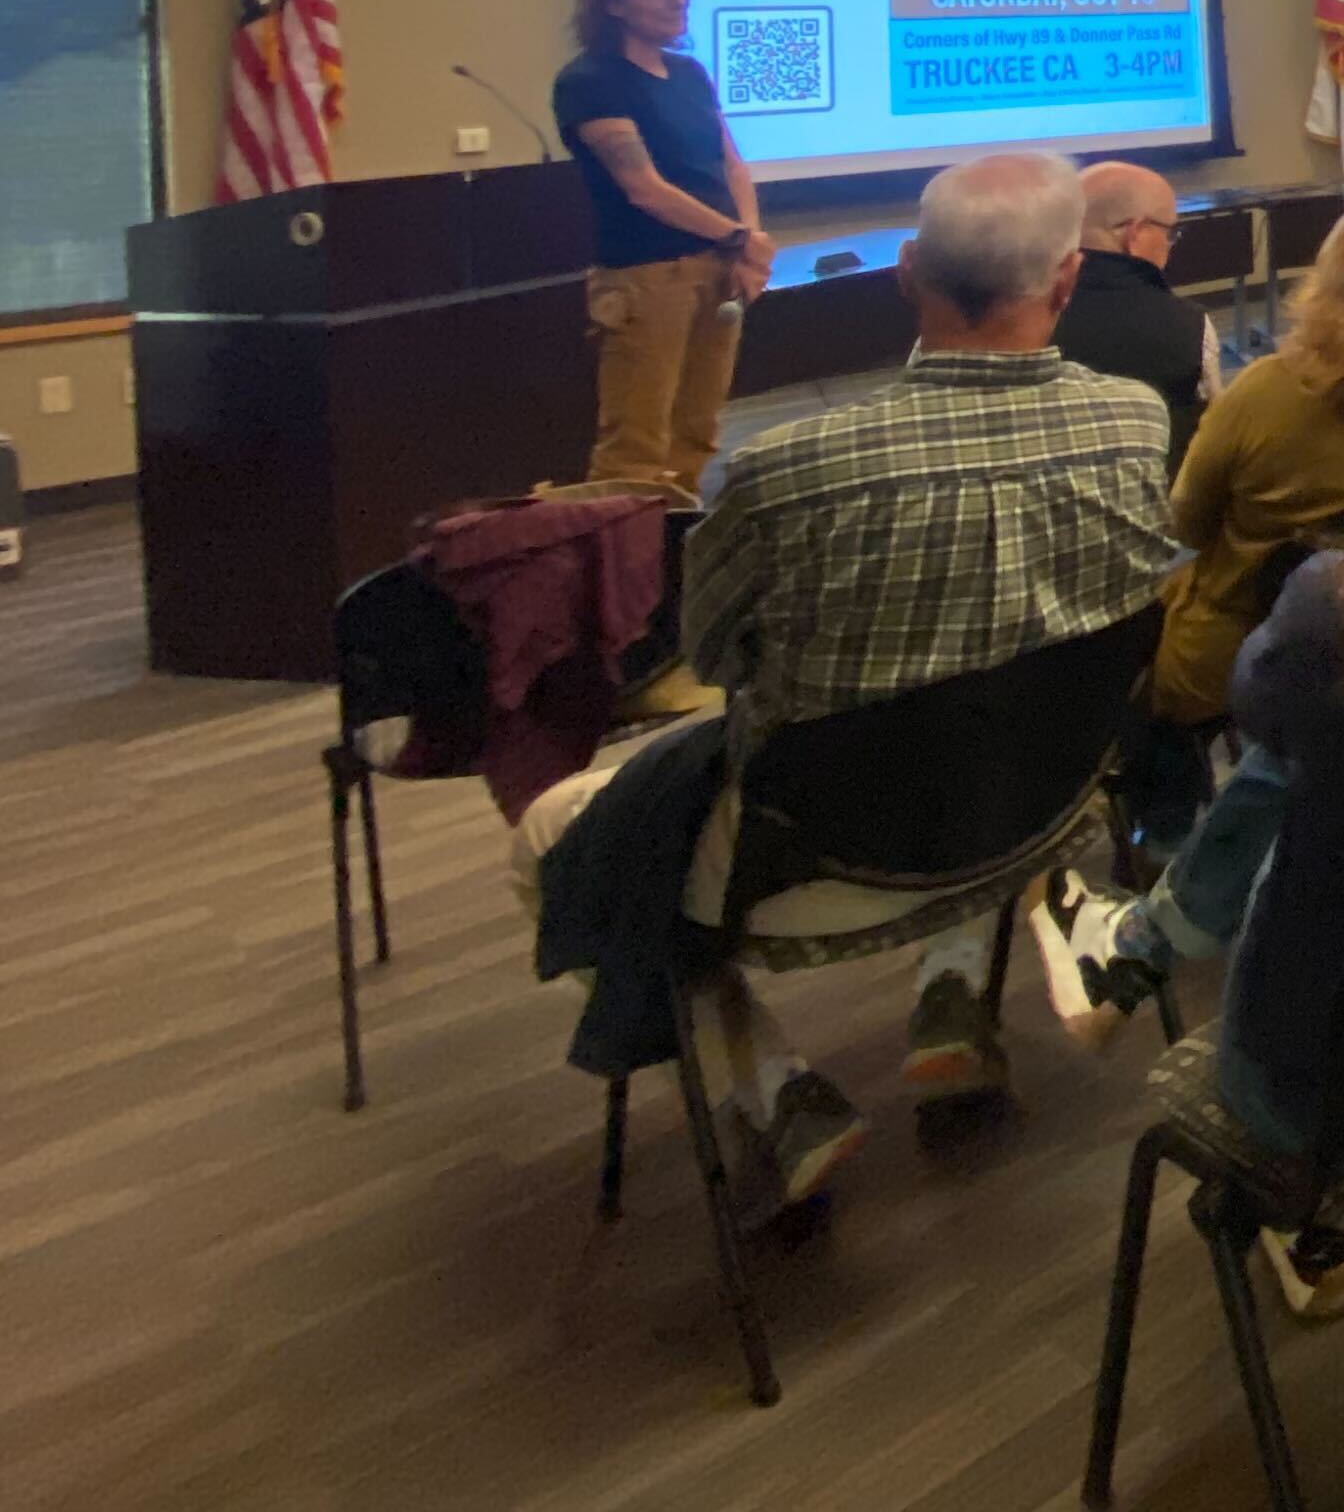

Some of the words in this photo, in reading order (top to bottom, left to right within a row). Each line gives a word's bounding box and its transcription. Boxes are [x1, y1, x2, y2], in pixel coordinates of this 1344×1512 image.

[904, 32, 969, 49] Corners
[974, 29, 990, 47] of
[993, 29, 1027, 49] Hwy
[1031, 28, 1050, 44] 89
[1054, 28, 1067, 43] &
[1070, 27, 1122, 44] Donner
[1127, 25, 1160, 41] Pass
[1163, 24, 1182, 40] Rd
[904, 56, 1036, 89] TRUCKEE
[1043, 53, 1079, 82] CA
[1105, 48, 1183, 78] 3-4PM
